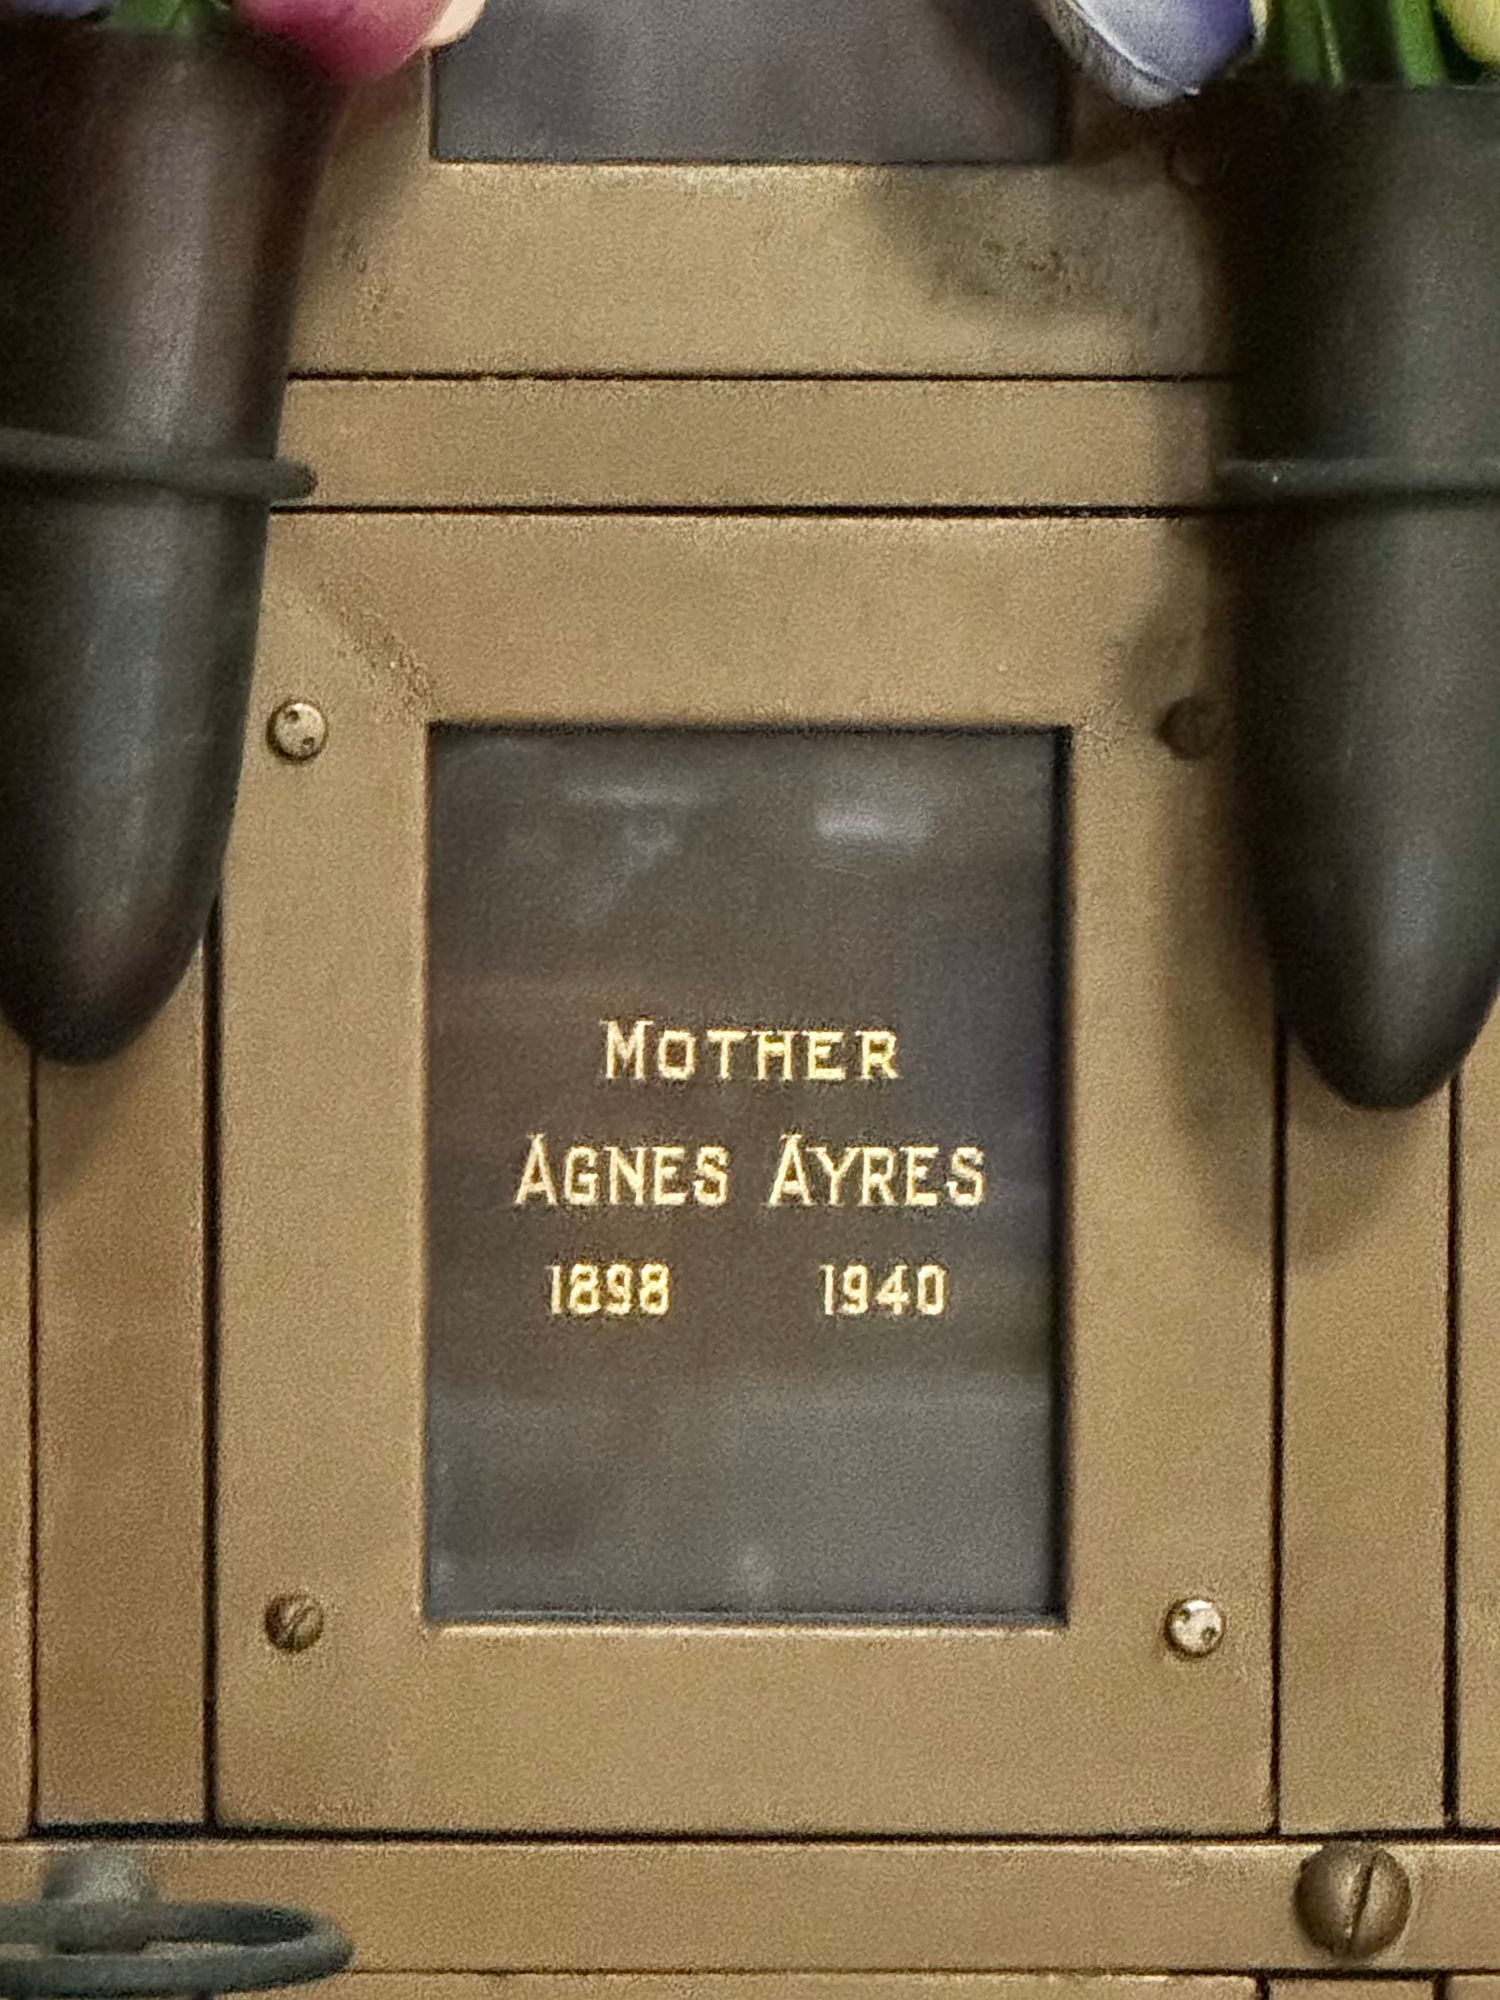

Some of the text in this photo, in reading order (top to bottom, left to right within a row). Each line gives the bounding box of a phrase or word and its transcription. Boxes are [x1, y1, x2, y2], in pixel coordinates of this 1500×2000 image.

[599, 1018, 902, 1082] MOTHER
[514, 1132, 987, 1208] AGNES AYRES
[548, 1261, 949, 1317] 1898 1940
